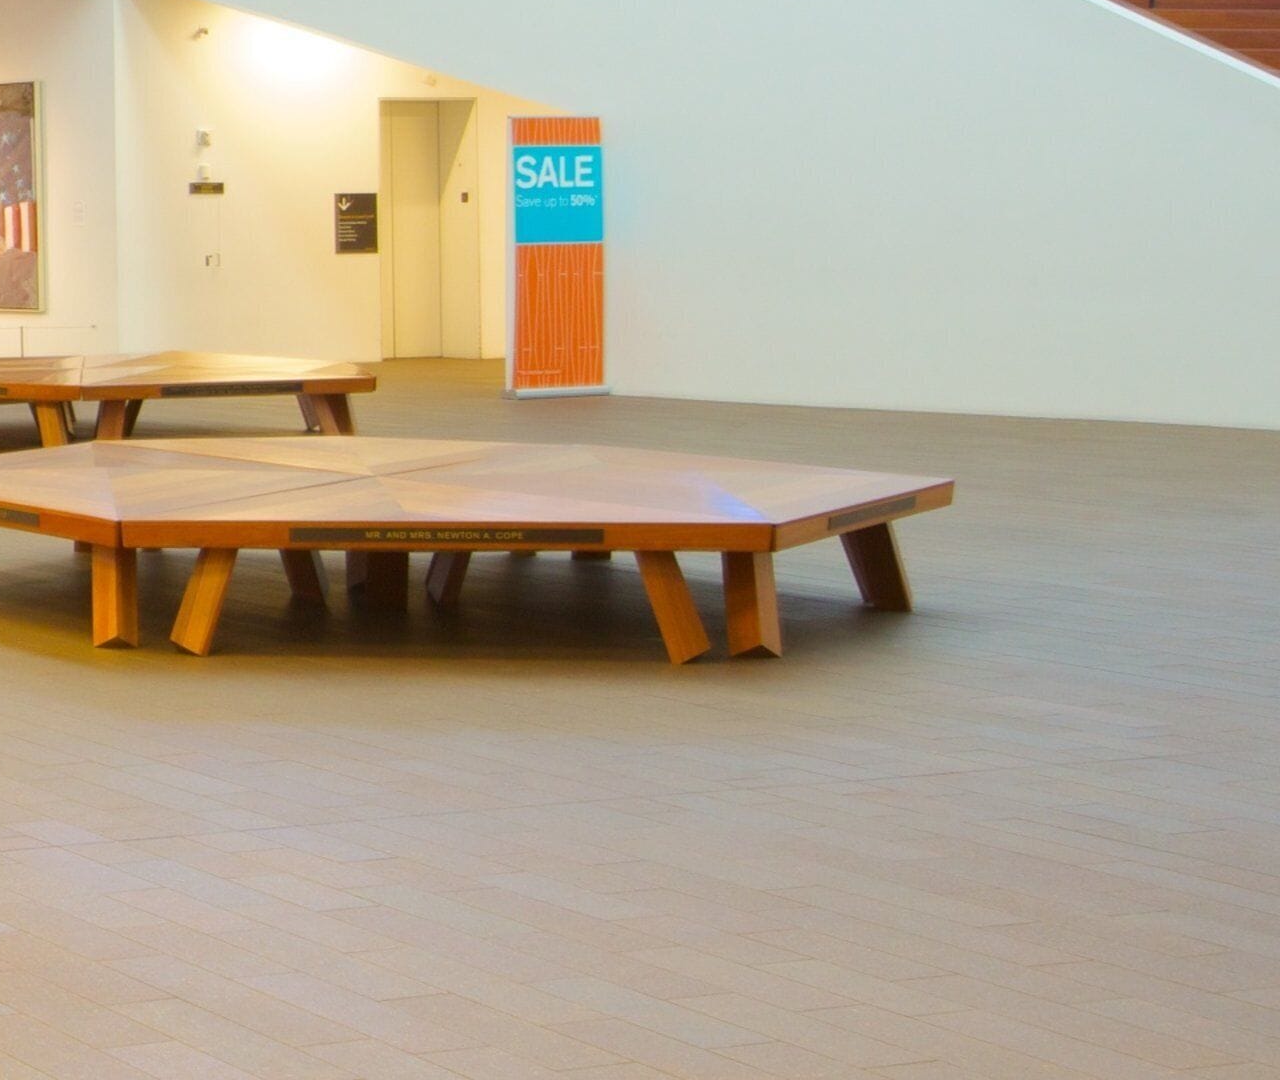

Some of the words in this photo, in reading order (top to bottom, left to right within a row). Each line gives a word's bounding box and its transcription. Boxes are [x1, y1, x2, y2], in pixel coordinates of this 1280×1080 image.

[515, 155, 594, 189] SALE
[515, 195, 541, 208] Save
[543, 198, 557, 210] up
[559, 196, 569, 207] to
[386, 531, 407, 539] AND
[436, 531, 481, 540] NEWTON
[495, 532, 524, 540] COPE
